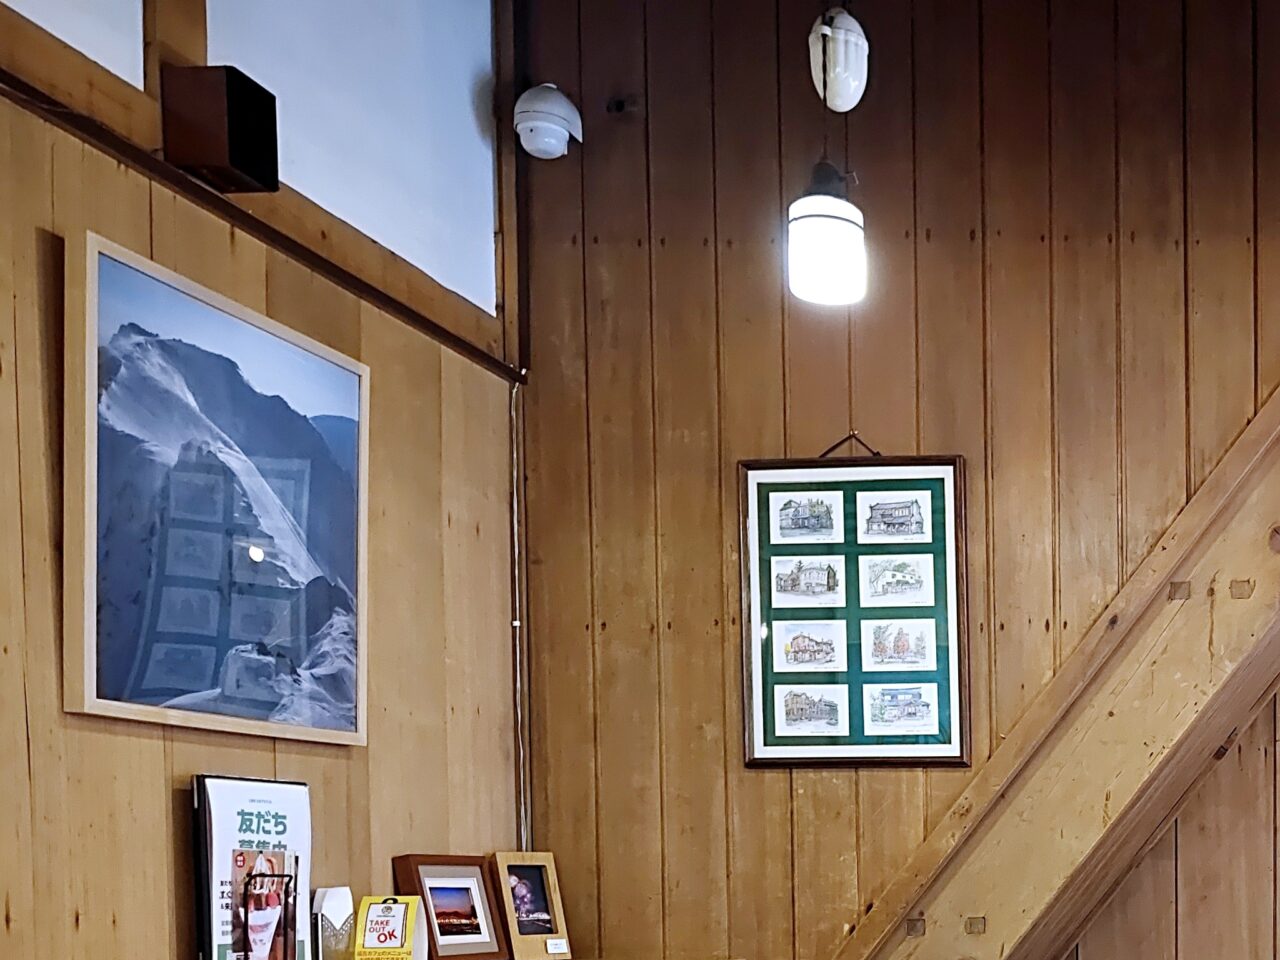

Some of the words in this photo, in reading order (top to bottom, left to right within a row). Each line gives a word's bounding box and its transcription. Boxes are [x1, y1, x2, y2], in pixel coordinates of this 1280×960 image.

[237, 809, 287, 835] 友だち
[377, 929, 397, 943] OK
